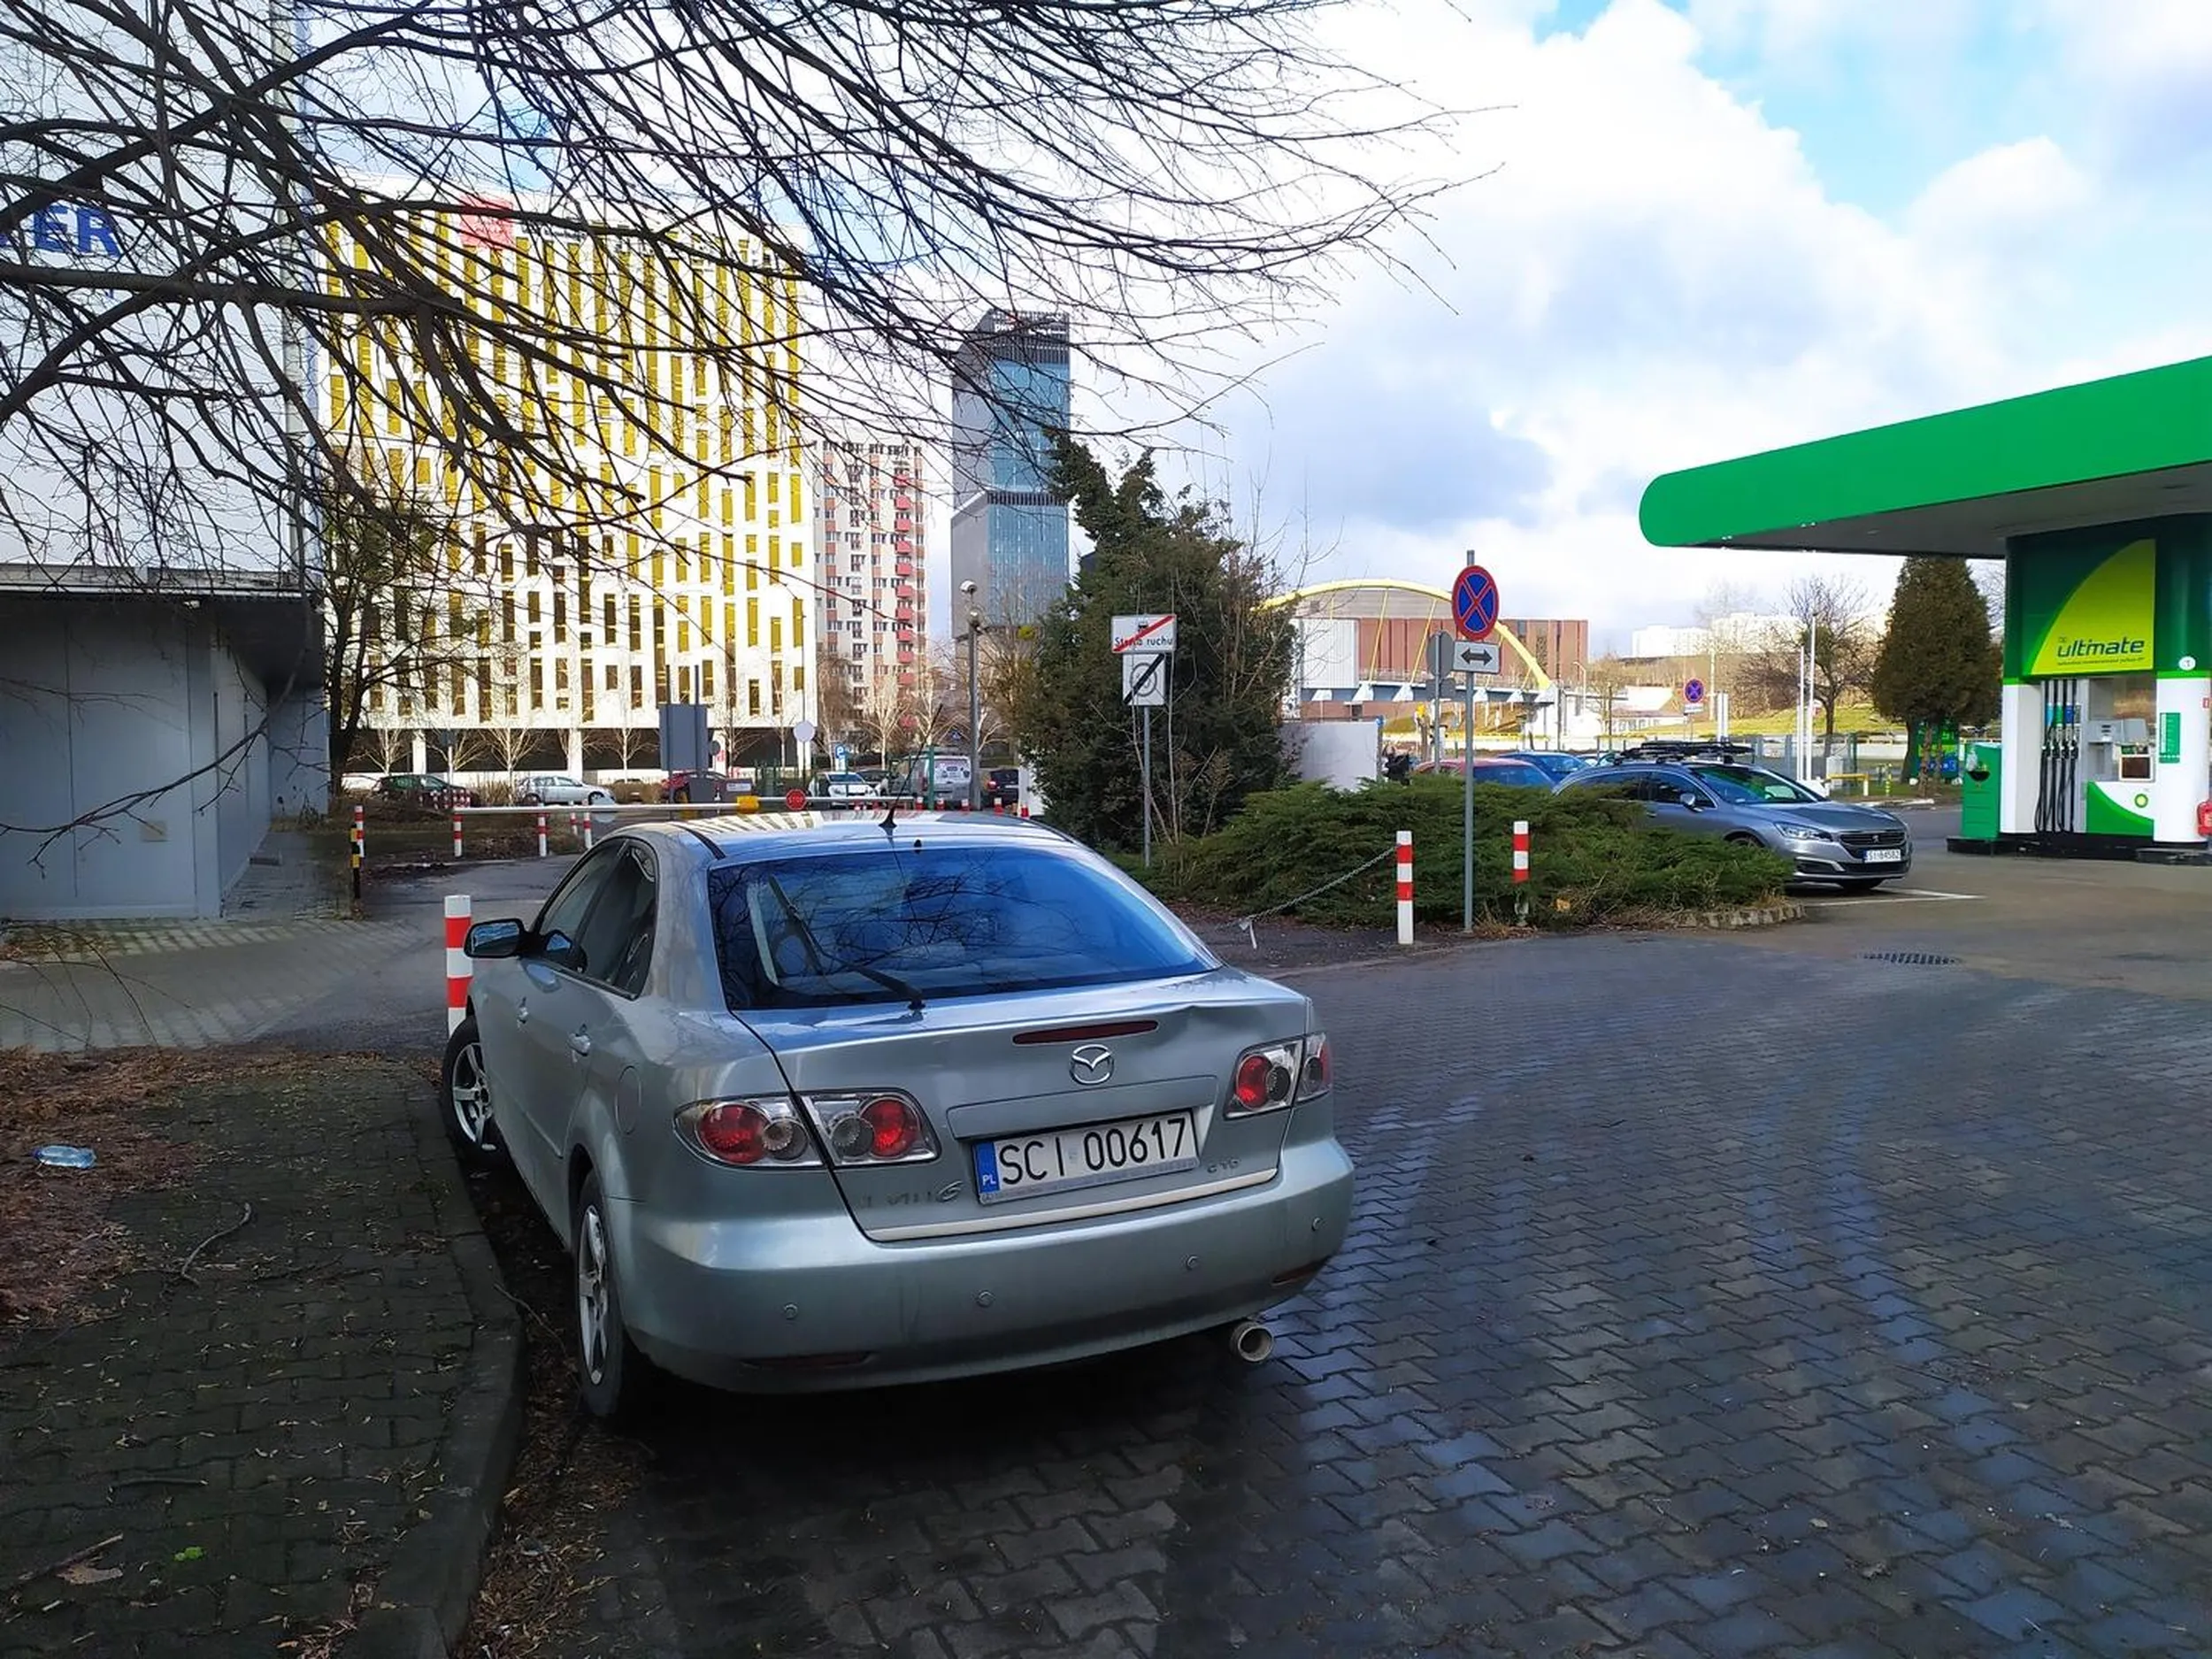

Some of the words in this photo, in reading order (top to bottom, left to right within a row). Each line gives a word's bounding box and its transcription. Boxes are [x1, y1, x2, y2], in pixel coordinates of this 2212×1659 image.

[0, 204, 121, 257] ER
[1147, 636, 1173, 647] ruchu
[2057, 636, 2145, 657] ultimate
[999, 1137, 1065, 1185] SCI
[1084, 1118, 1186, 1171] 00617
[982, 1174, 996, 1187] PL
